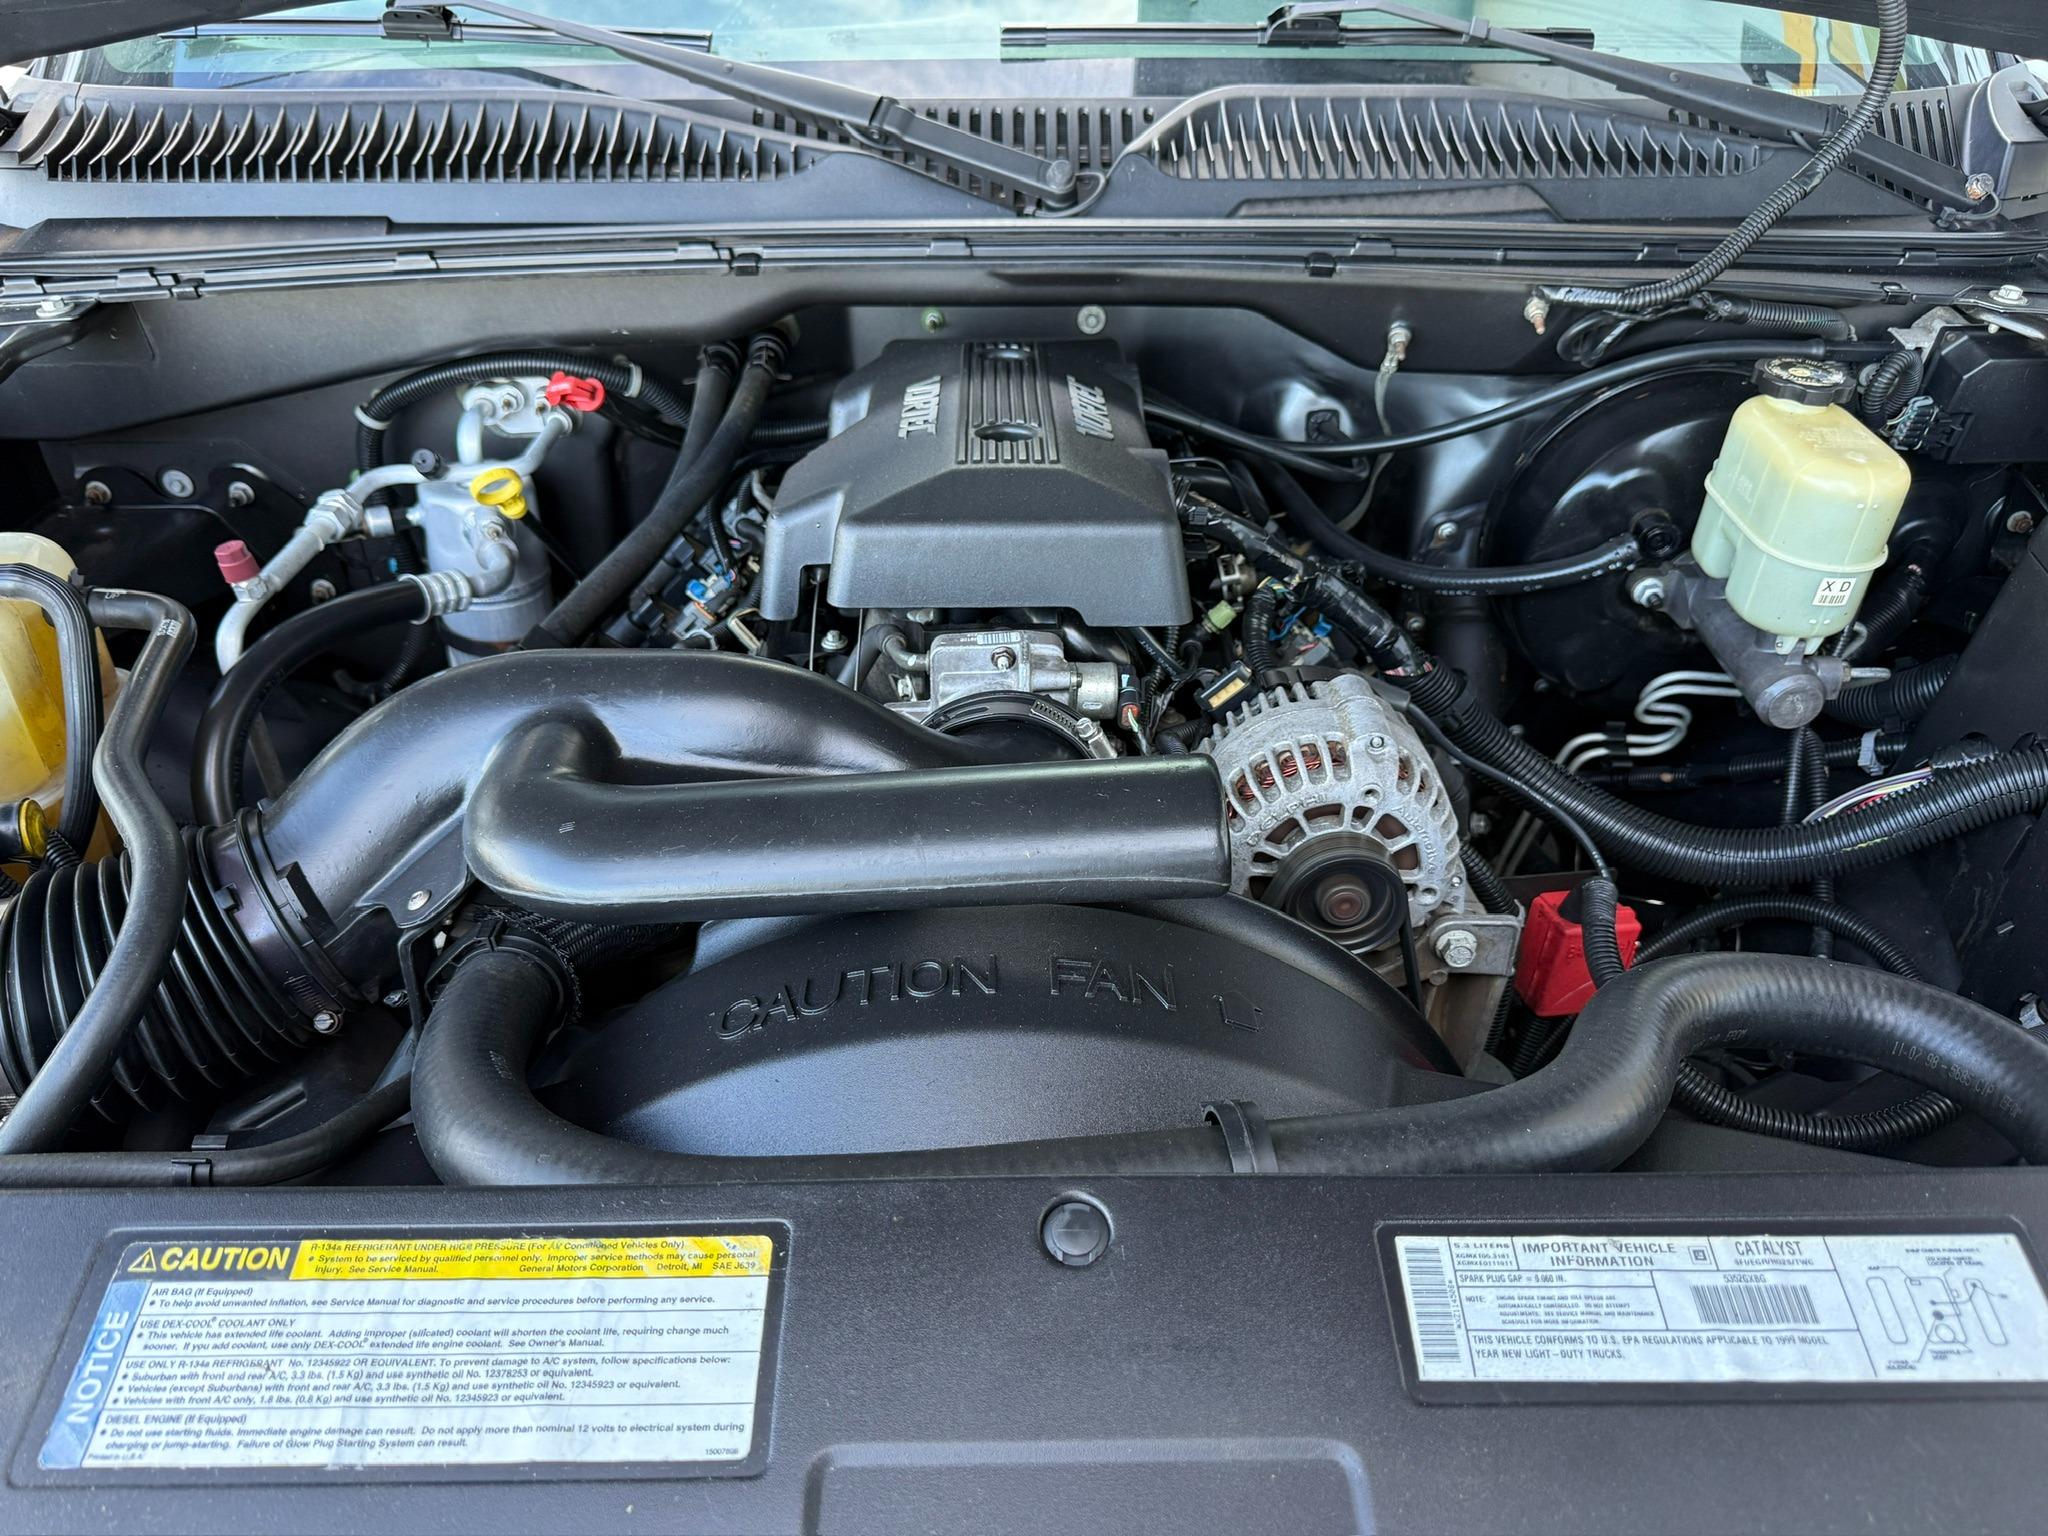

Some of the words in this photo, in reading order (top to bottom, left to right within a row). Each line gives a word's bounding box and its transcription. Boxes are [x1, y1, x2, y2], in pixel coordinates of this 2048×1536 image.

[898, 375, 942, 440] VORTEC
[1822, 581, 1836, 592] X
[1839, 581, 1852, 592] D
[1390, 805, 1438, 875] Automotive
[714, 954, 997, 1039] CAUTION
[1050, 958, 1177, 1011] FAN
[1522, 1242, 1609, 1254] IMPORTANT
[1614, 1242, 1677, 1254] VEHICLE
[1734, 1241, 1803, 1256] CATALYST
[160, 1247, 290, 1272] CAUTION
[318, 1254, 352, 1265] System
[379, 1253, 417, 1262] serviced
[433, 1253, 472, 1264] qualified
[473, 1252, 519, 1263] personnel
[521, 1252, 542, 1263] only.
[547, 1251, 588, 1262] Improper
[590, 1251, 622, 1260] service
[625, 1251, 664, 1260] methods
[716, 1250, 756, 1261] personal
[1550, 1255, 1655, 1267] INFORMATION
[368, 1264, 402, 1273] Service
[404, 1264, 439, 1273] Manual.
[519, 1263, 554, 1272] General
[556, 1263, 587, 1271] Motors
[590, 1262, 644, 1273] Corporation
[656, 1262, 689, 1272] Detroit,
[734, 1261, 756, 1270] J639
[1459, 1274, 1484, 1283] SPARK
[1486, 1274, 1506, 1283] PLUG
[1507, 1274, 1522, 1283] GAP
[1556, 1274, 1567, 1283] IN.
[151, 1287, 169, 1296] AIR
[170, 1287, 192, 1296] BAG
[206, 1287, 253, 1298] Equipped)
[159, 1298, 172, 1307] To
[175, 1298, 192, 1309] help
[195, 1298, 219, 1307] avoid
[222, 1298, 266, 1307] unwanted
[269, 1297, 308, 1308] inflation,
[330, 1297, 364, 1306] Service
[366, 1296, 400, 1306] Manual
[402, 1296, 415, 1305] for
[418, 1296, 465, 1307] diagnostic
[467, 1296, 484, 1305] and
[487, 1296, 519, 1305] service
[522, 1295, 574, 1306] procedures
[576, 1295, 605, 1304] before
[607, 1295, 658, 1306] performing
[660, 1296, 677, 1306] any
[679, 1294, 715, 1303] service.
[140, 1319, 160, 1328] USE
[218, 1318, 265, 1328] COOLANT
[267, 1318, 296, 1327] ONLY
[147, 1330, 167, 1339] This
[170, 1330, 204, 1339] vehicle
[206, 1330, 223, 1338] has
[226, 1329, 270, 1338] extended
[286, 1329, 324, 1338] coolant.
[328, 1329, 361, 1340] Adding
[364, 1328, 405, 1340] improper
[408, 1328, 453, 1338] (silicated)
[457, 1328, 491, 1337] coolant
[512, 1327, 547, 1336] shorten
[566, 1327, 600, 1336] coolant
[603, 1327, 620, 1337] life,
[622, 1326, 664, 1338] requiring
[666, 1326, 701, 1338] change
[703, 1326, 729, 1335] much
[231, 1341, 268, 1351] coolant,
[290, 1340, 311, 1351] only
[370, 1339, 414, 1349] extended
[432, 1339, 463, 1350] engine
[466, 1339, 502, 1348] coolant.
[528, 1338, 566, 1347] Owner's
[569, 1338, 604, 1347] Manual.
[1473, 1335, 1494, 1345] THIS
[1496, 1335, 1531, 1345] VEHICLE
[1534, 1335, 1583, 1345] CONFORMS
[1586, 1335, 1598, 1345] TO
[1601, 1335, 1619, 1345] U.S.
[1622, 1335, 1639, 1345] EPA
[1642, 1335, 1704, 1345] REGULATIONS
[1706, 1335, 1759, 1345] APPLICABLE
[1761, 1335, 1772, 1345] TO
[1775, 1335, 1796, 1345] 1999
[1799, 1335, 1828, 1345] MODEL
[1476, 1350, 1499, 1359] YEAR
[1501, 1350, 1522, 1359] NEW
[1587, 1350, 1625, 1359] TRUCKS.
[65, 1311, 129, 1424] NOTICE
[125, 1359, 147, 1368] USE
[148, 1359, 177, 1368] ONLY
[178, 1359, 210, 1368] R-134a
[212, 1358, 284, 1368] REFRIGERANT
[370, 1357, 437, 1367] EQUIVALENT.
[457, 1356, 490, 1368] prevent
[492, 1356, 528, 1368] damage
[542, 1356, 561, 1365] A/C
[563, 1356, 599, 1367] system,
[601, 1355, 629, 1365] follow
[632, 1355, 697, 1367] specifications
[700, 1355, 731, 1364] below:
[405, 1369, 451, 1381] synthetic
[542, 1368, 594, 1380] equivalent.
[492, 1381, 534, 1392] synthetic
[629, 1380, 681, 1391] equivalent.
[290, 1426, 322, 1438] engine
[324, 1426, 363, 1437] damage
[385, 1425, 416, 1435] result.
[456, 1425, 483, 1436] apply
[535, 1424, 575, 1434] nominal
[629, 1423, 673, 1433] electrical
[676, 1423, 711, 1435] system
[713, 1423, 744, 1434] during
